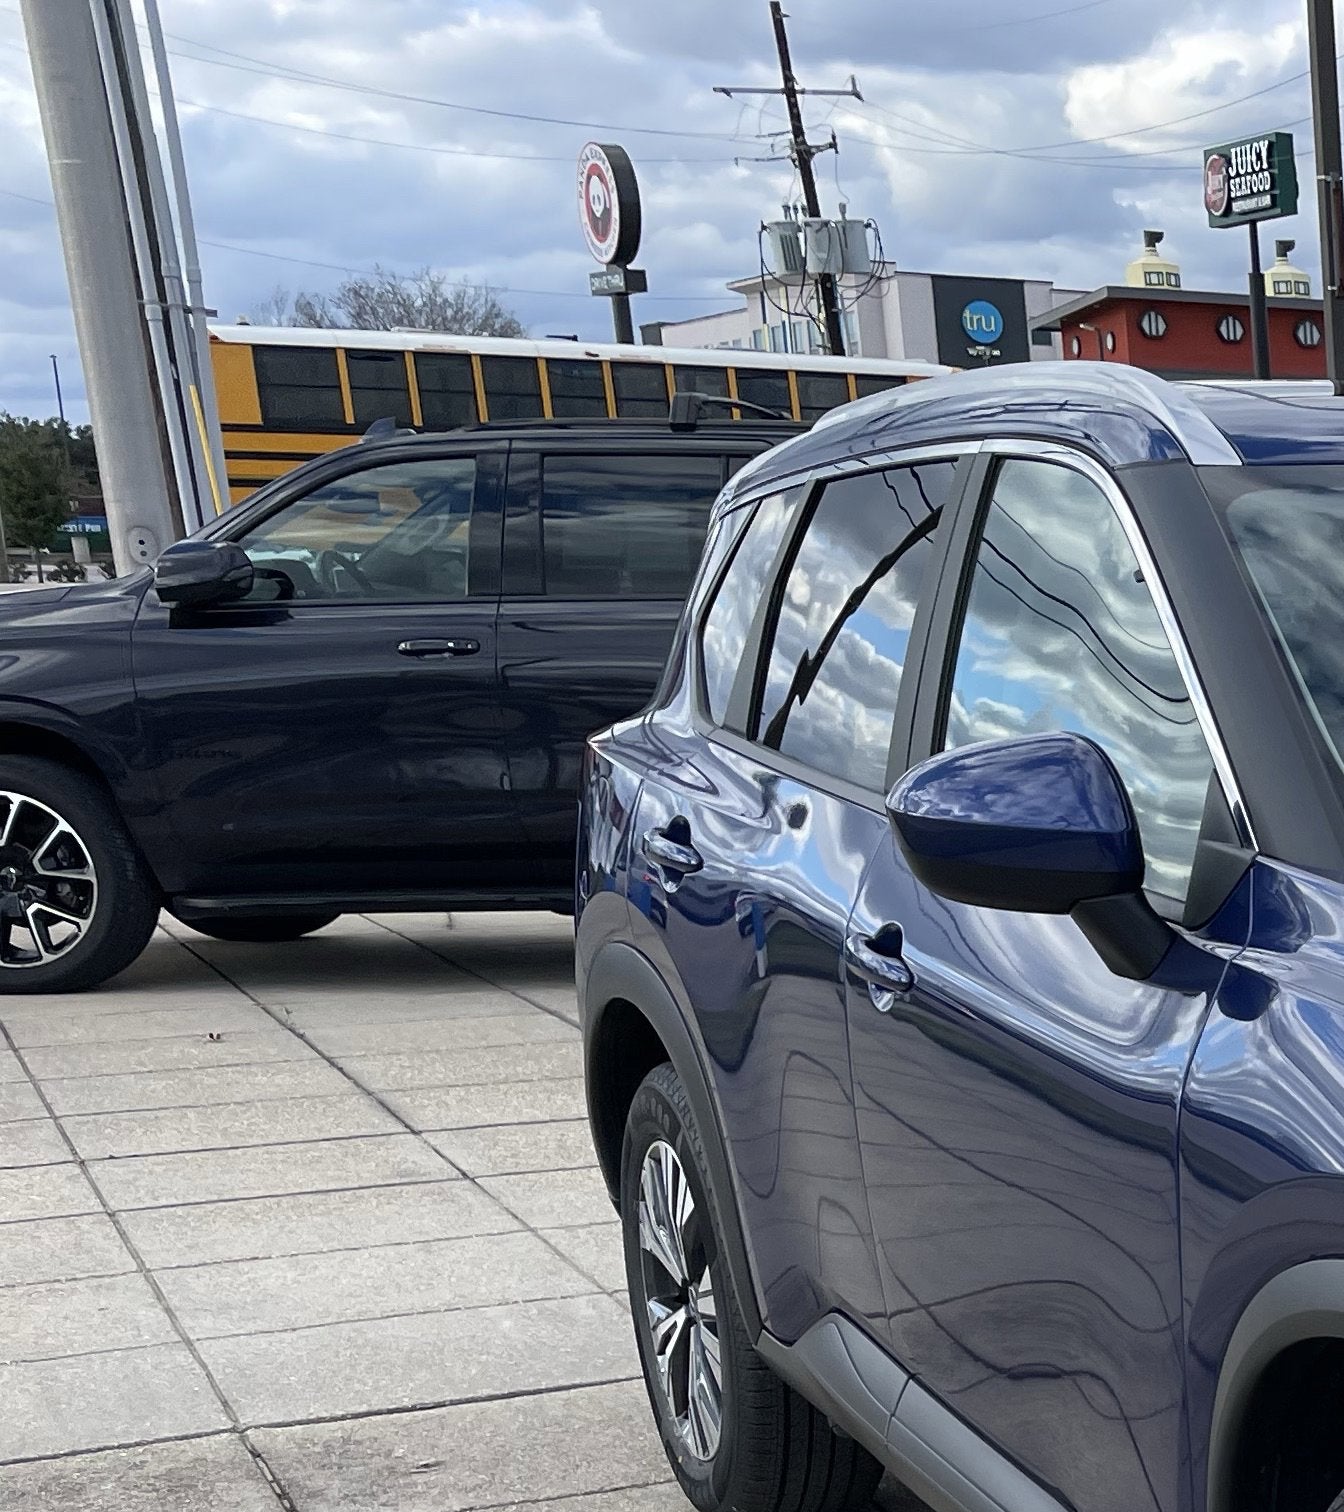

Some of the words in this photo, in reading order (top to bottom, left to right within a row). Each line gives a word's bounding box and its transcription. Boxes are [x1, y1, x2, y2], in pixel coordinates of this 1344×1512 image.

[1228, 140, 1269, 177] JUICY
[1230, 171, 1271, 198] SEAFOOD
[963, 309, 996, 332] tru
